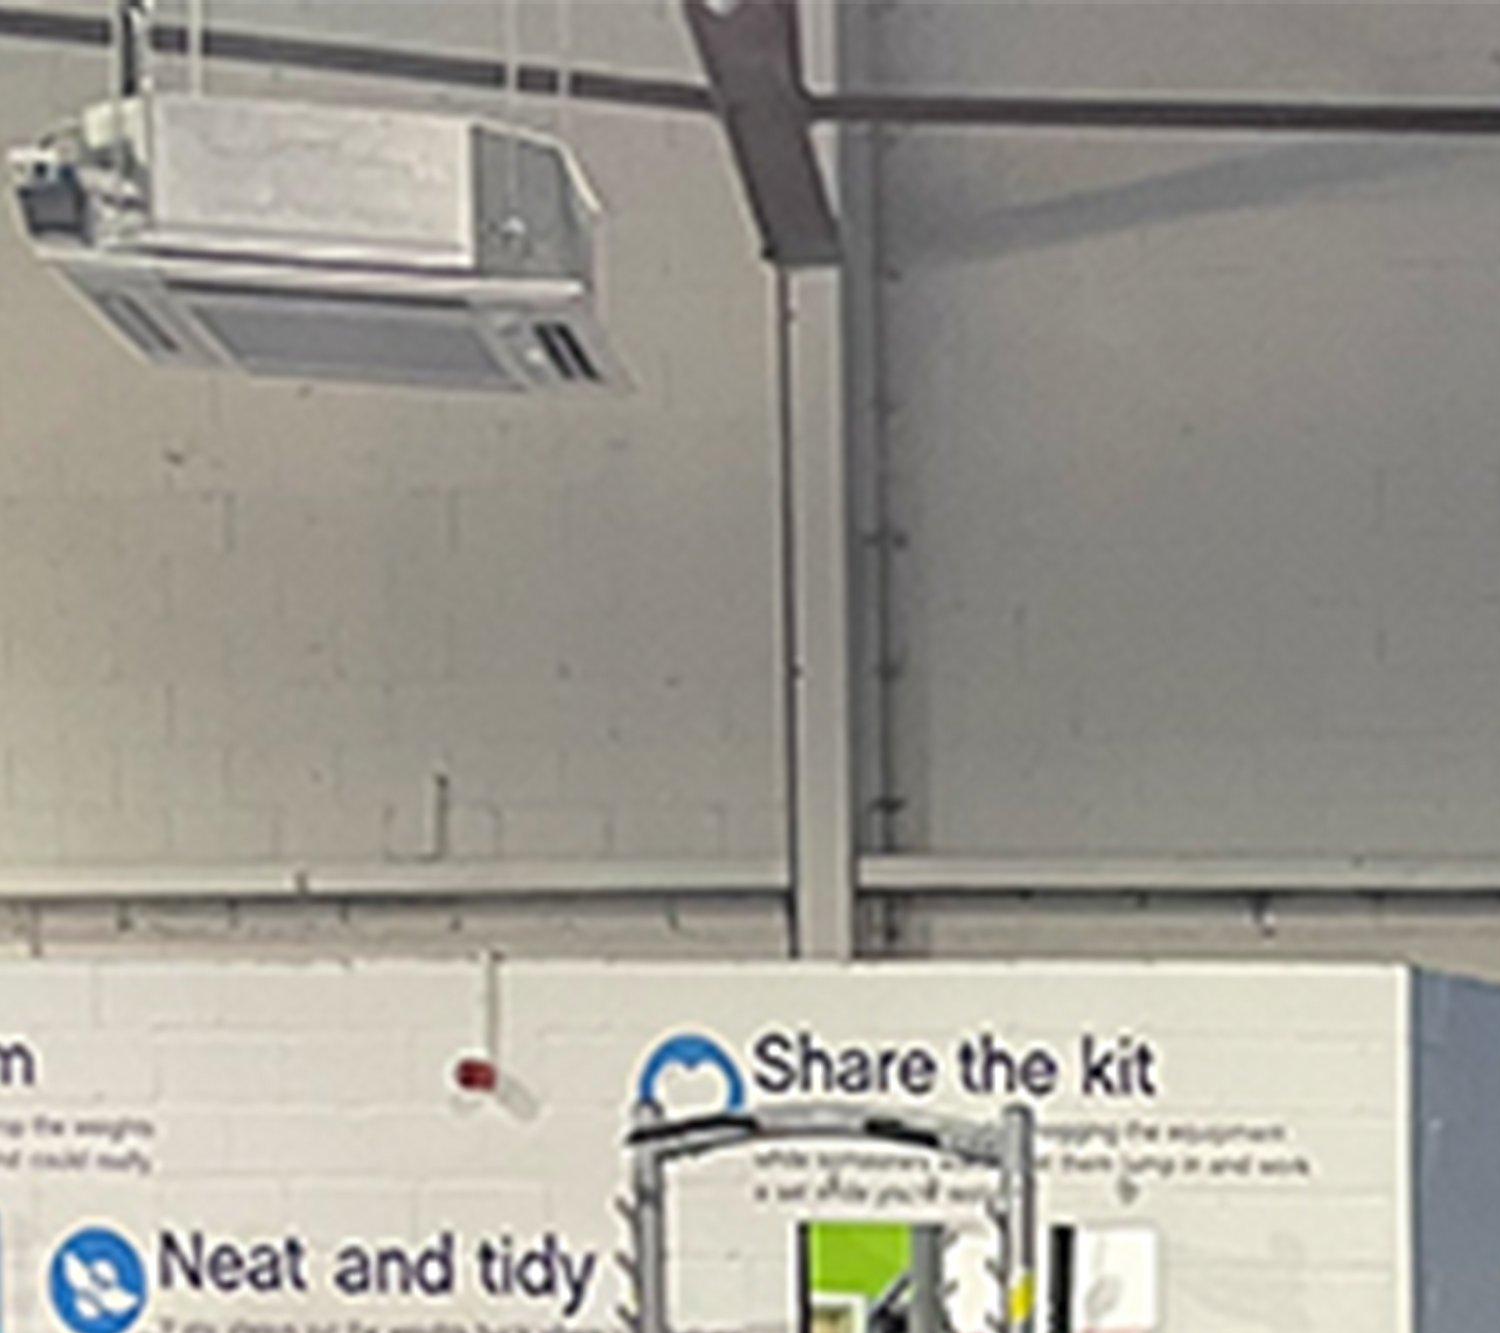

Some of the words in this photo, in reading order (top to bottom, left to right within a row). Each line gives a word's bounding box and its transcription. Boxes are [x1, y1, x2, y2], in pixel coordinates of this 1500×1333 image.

[754, 1031, 938, 1095] Share
[958, 1033, 1058, 1096] the
[1081, 1033, 1157, 1096] kit
[158, 1230, 307, 1293] Neat
[334, 1231, 455, 1295] and
[477, 1231, 597, 1319] tidy
